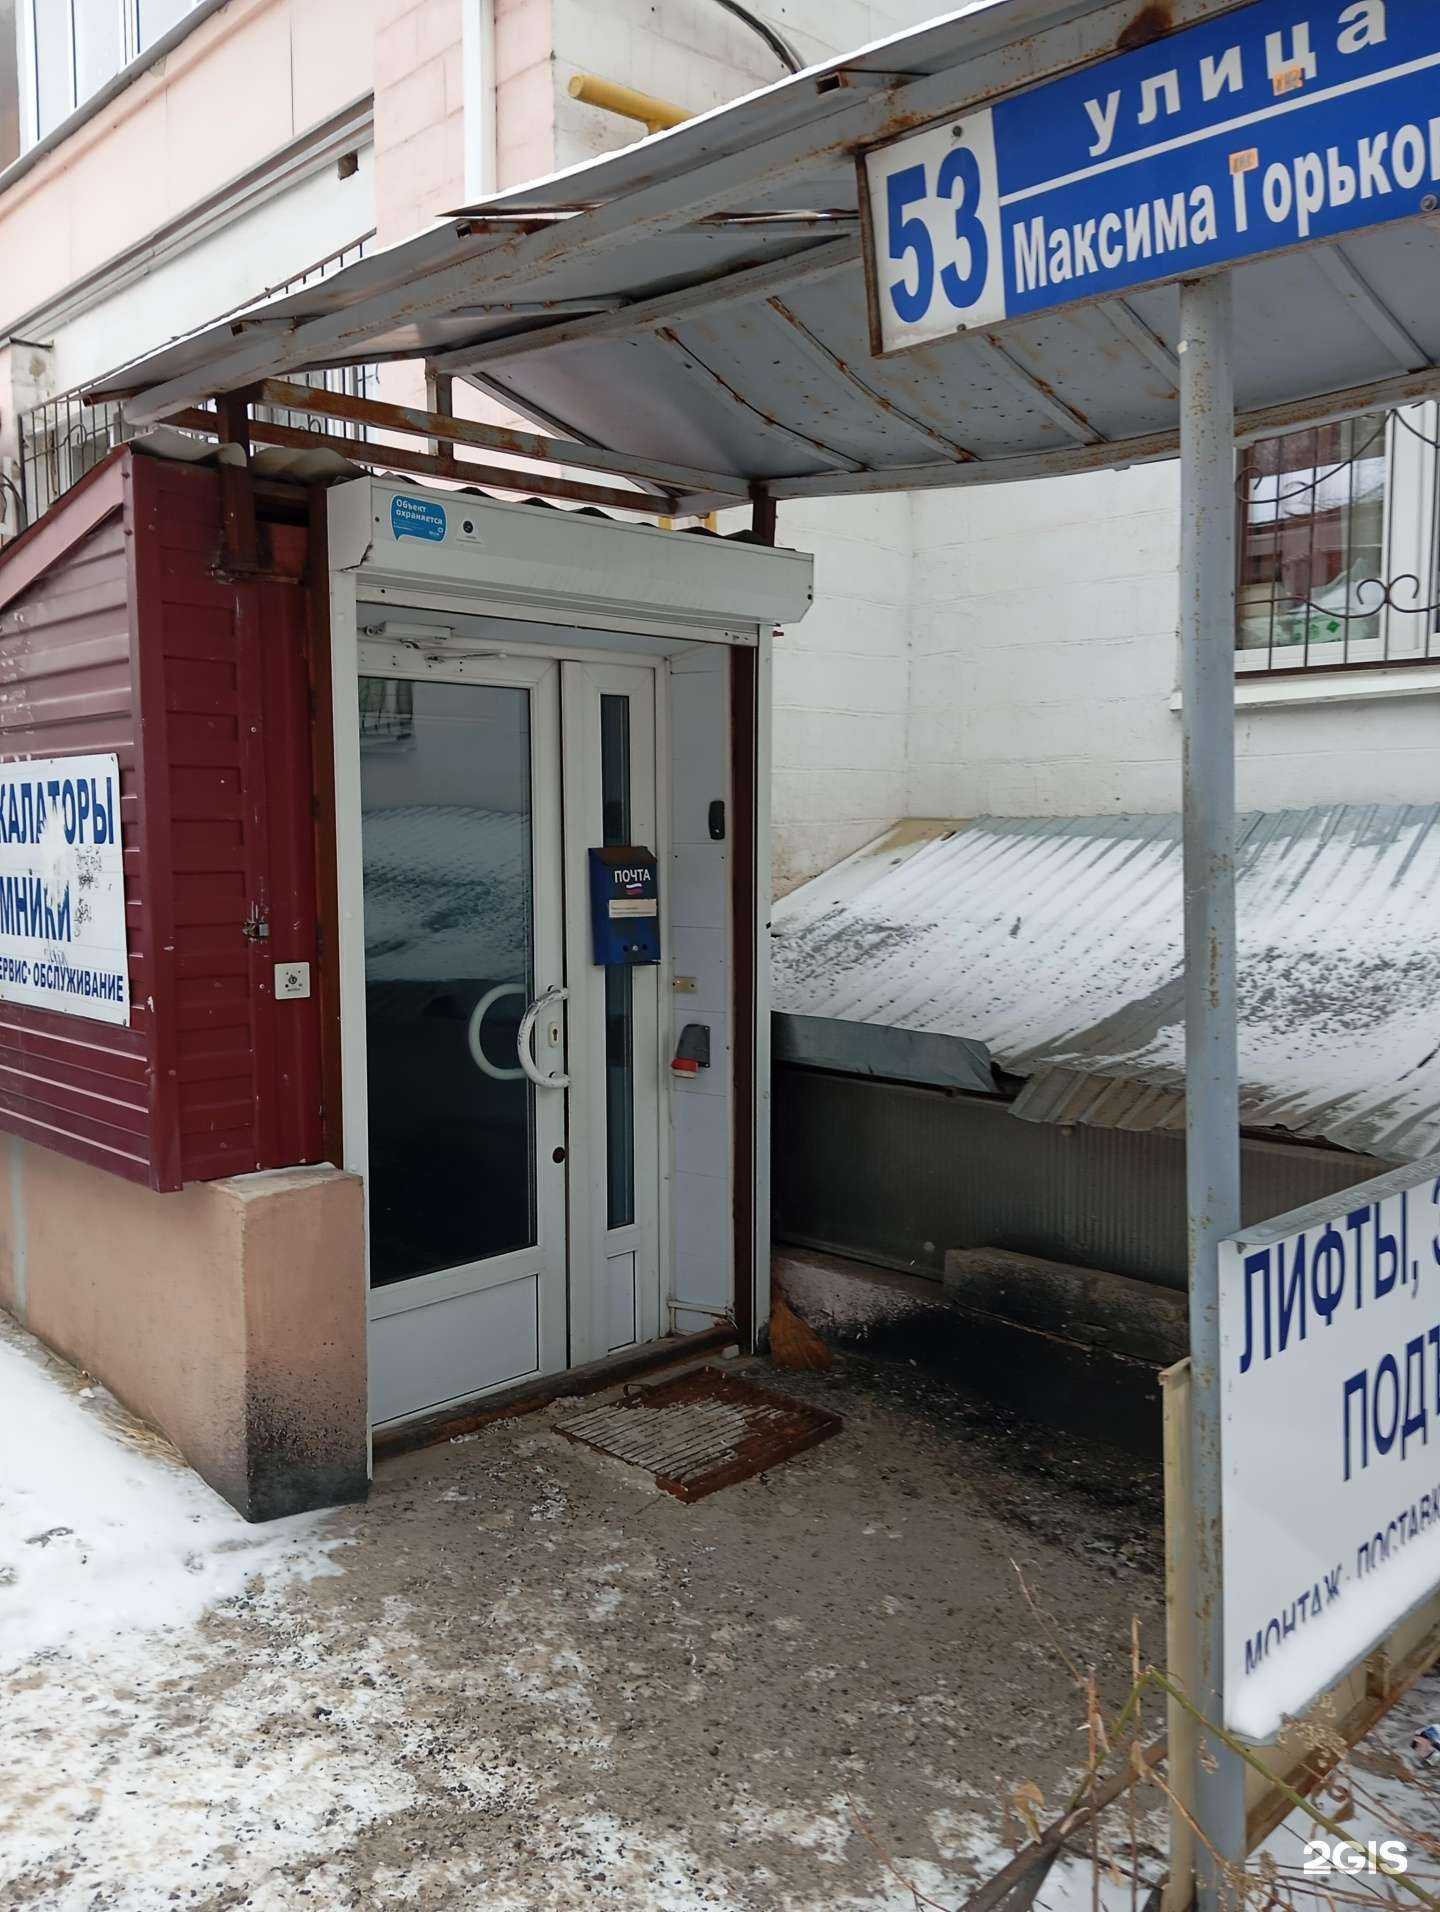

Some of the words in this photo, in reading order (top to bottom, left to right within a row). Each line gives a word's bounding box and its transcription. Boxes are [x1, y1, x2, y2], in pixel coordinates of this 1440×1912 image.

[1084, 0, 1387, 157] улица
[886, 147, 989, 324] 53
[1012, 183, 1217, 294] Максима
[396, 499, 426, 513] Объект
[396, 509, 443, 525] охраняется
[614, 869, 651, 883] ПОЧТА
[33, 962, 124, 1002] ОБСЛУЖИВАНИЕ
[1240, 1190, 1419, 1374] ЛИФТЫ,
